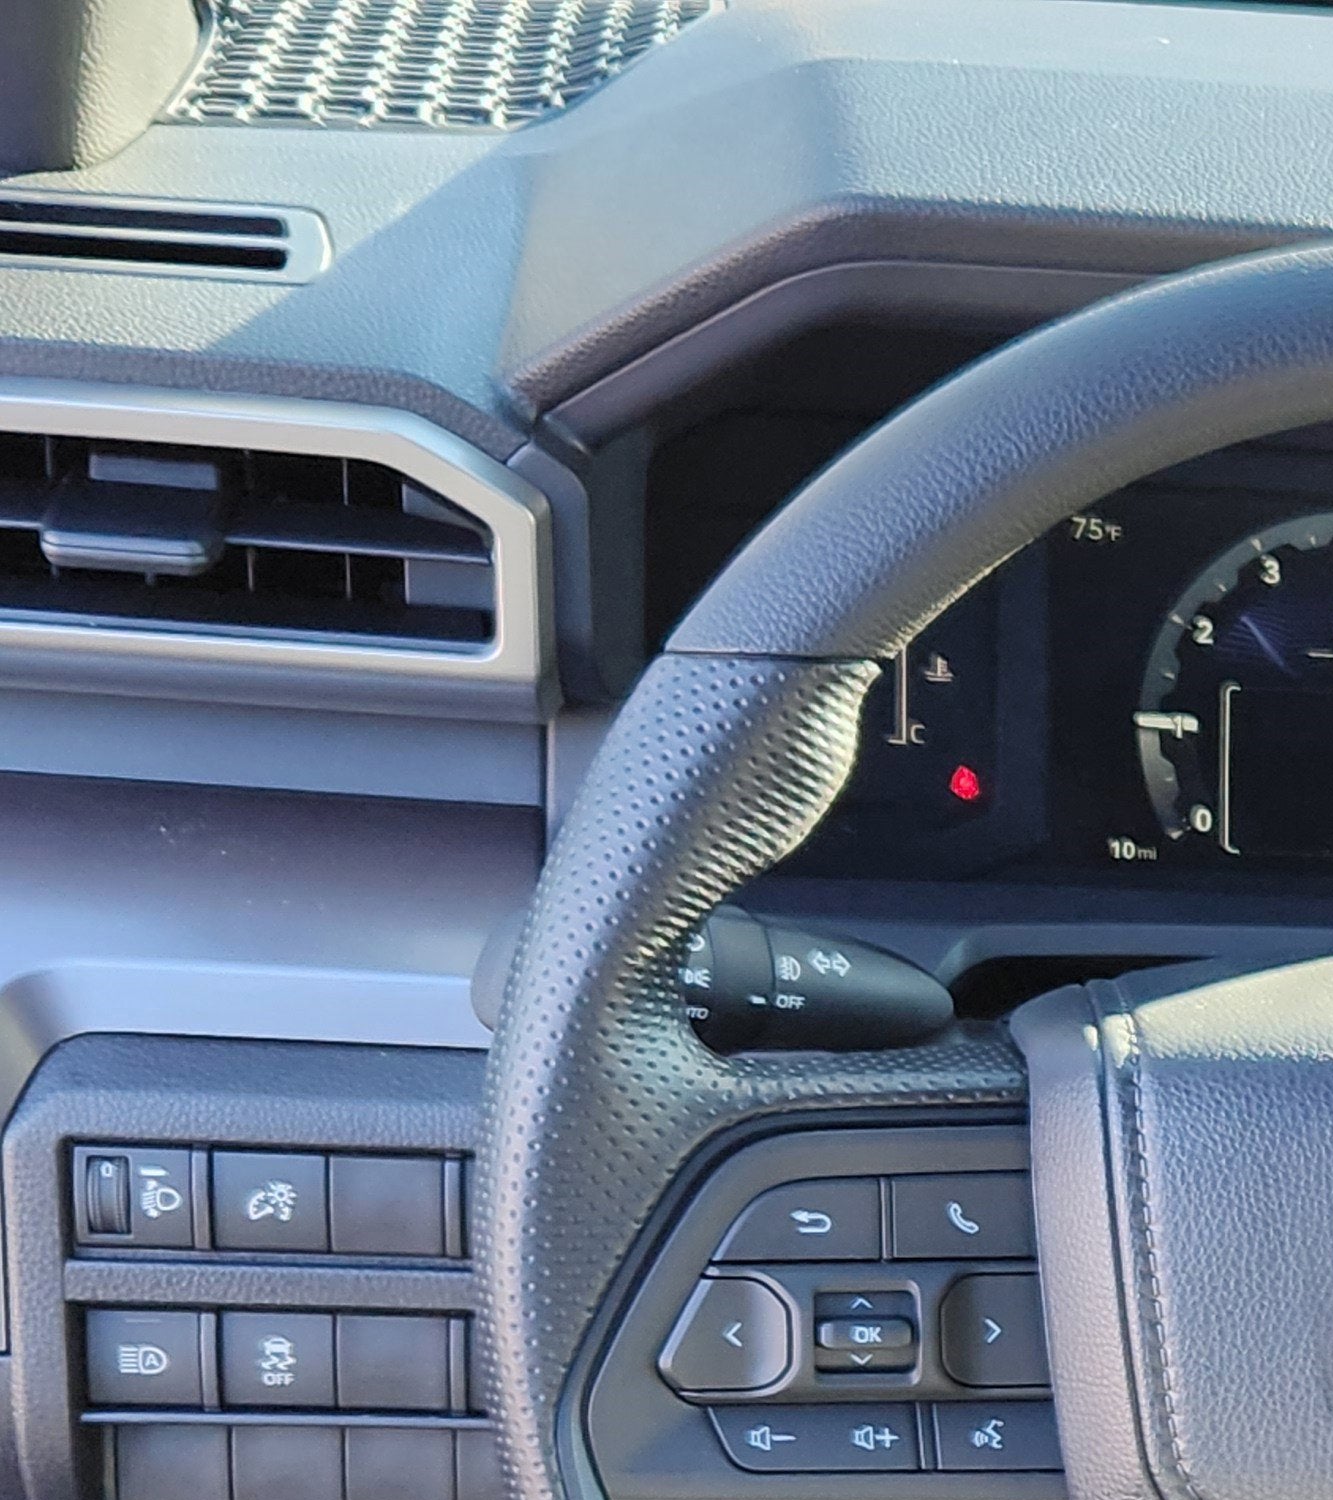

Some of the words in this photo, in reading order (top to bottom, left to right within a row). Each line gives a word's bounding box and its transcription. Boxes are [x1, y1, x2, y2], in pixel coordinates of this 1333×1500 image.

[1260, 556, 1281, 585] 3
[1193, 616, 1214, 645] 2
[1190, 806, 1213, 834] 0
[776, 994, 806, 1010] OFF
[853, 1326, 882, 1344] OK
[262, 1373, 295, 1386] OFF
